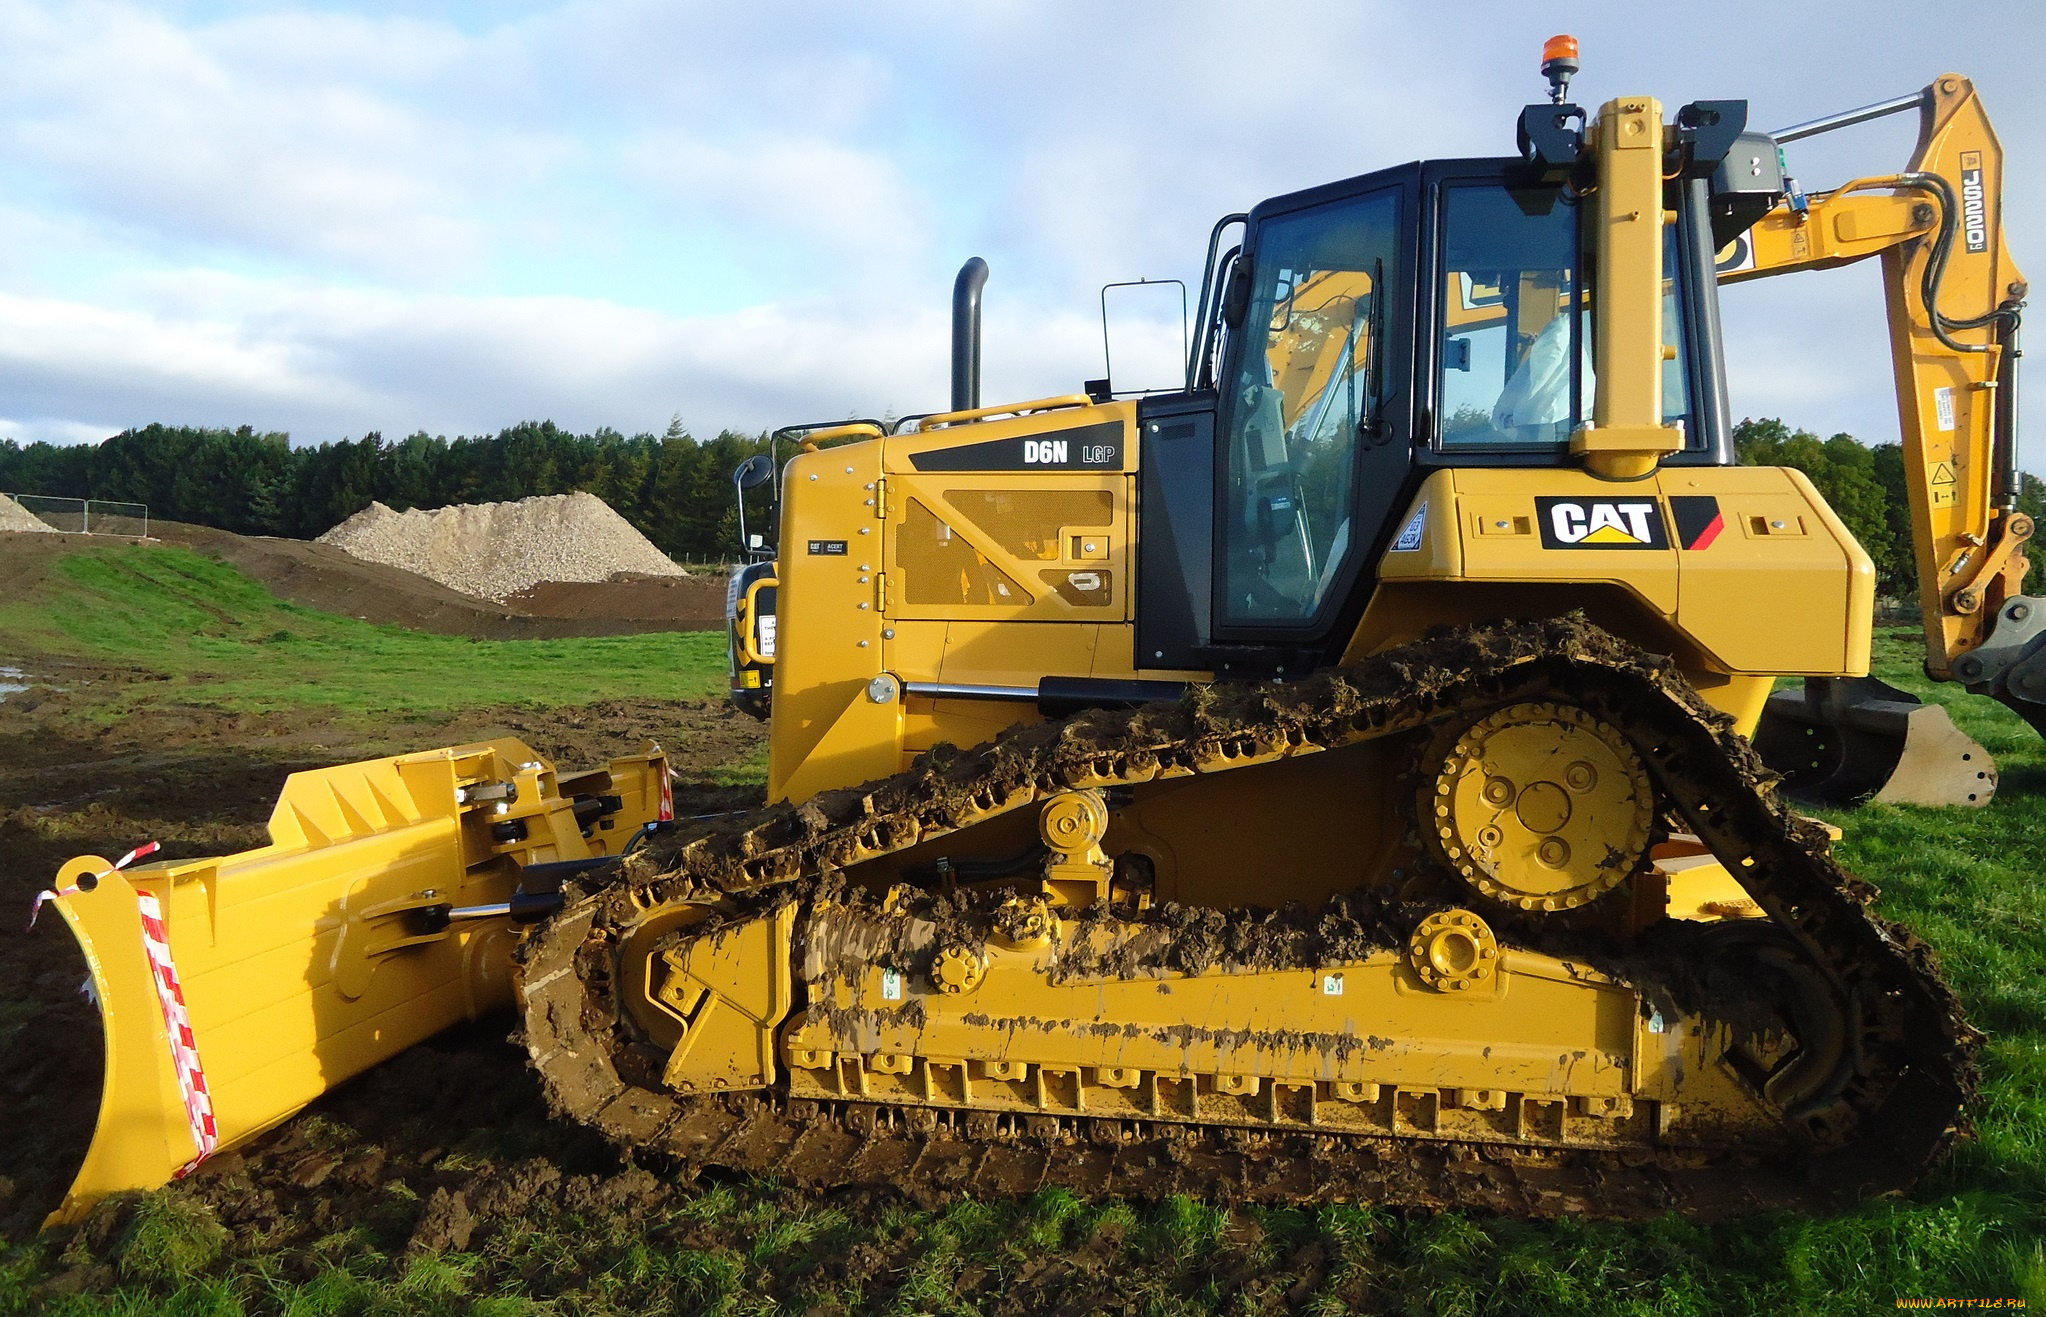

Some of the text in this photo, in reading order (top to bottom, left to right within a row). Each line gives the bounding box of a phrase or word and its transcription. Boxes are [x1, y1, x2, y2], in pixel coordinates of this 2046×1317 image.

[1963, 170, 1984, 244] JS220
[1024, 440, 1116, 464] D6N LGP
[1551, 503, 1654, 544] CAT
